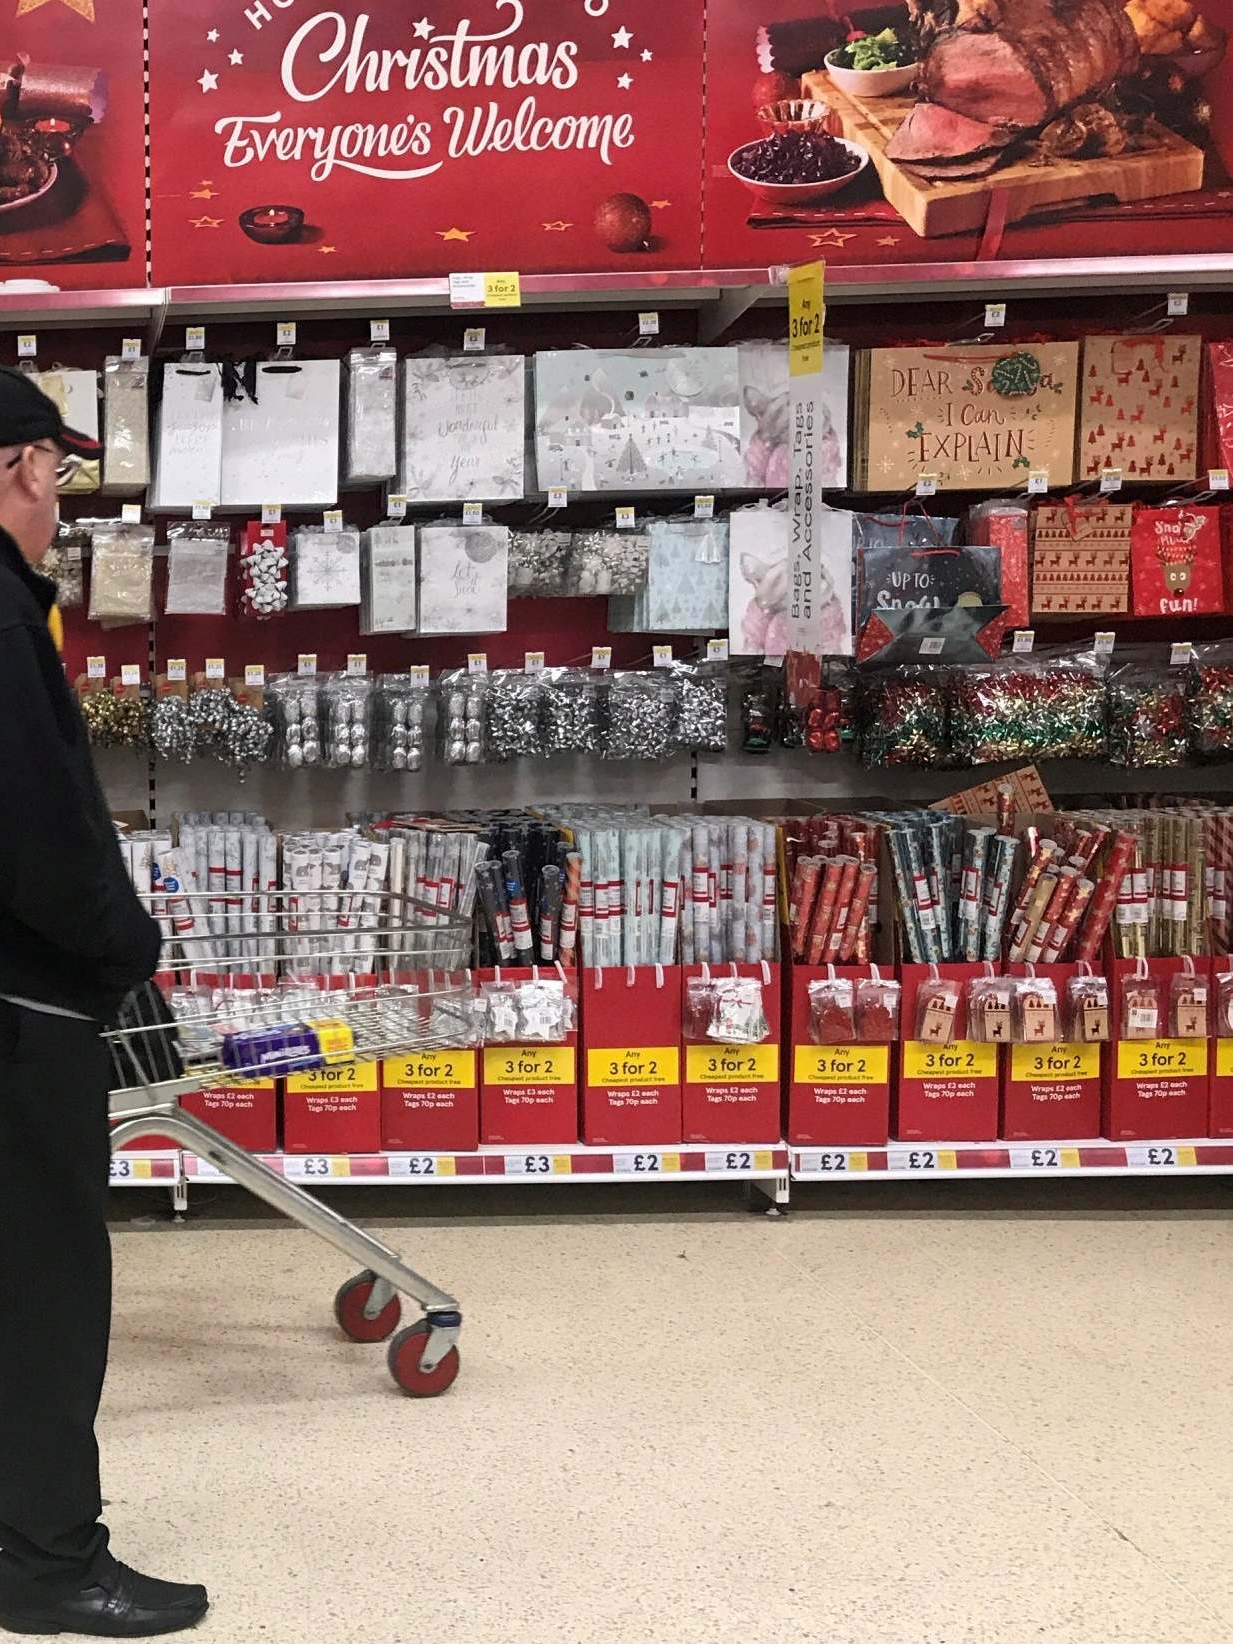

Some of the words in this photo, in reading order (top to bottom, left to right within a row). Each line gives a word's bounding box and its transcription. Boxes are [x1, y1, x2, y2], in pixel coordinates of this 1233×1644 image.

[281, 0, 578, 102] Christmas
[214, 111, 443, 181] Everyone's
[443, 96, 635, 166] Welcome
[792, 318, 797, 338] 3
[799, 316, 812, 336] for
[814, 313, 820, 333] 2
[892, 368, 953, 397] DEAR
[946, 402, 953, 426] I
[961, 404, 1004, 426] Can
[919, 429, 1024, 462] EXPLAIN
[802, 401, 814, 561] Accessories
[892, 571, 911, 590] UP
[913, 572, 930, 589] TO
[802, 571, 812, 619] and
[1159, 598, 1198, 614] fun!
[724, 1047, 740, 1056] Any
[1051, 1044, 1067, 1054] Any
[1155, 1041, 1171, 1050] Any
[421, 1052, 437, 1061] Any
[625, 1050, 641, 1059] Any
[925, 1054, 935, 1066] 3
[939, 1053, 961, 1067] for
[965, 1053, 975, 1066] 2
[1034, 1057, 1043, 1069] 3
[1046, 1056, 1070, 1069] for
[1072, 1056, 1081, 1069] 2
[1139, 1053, 1148, 1066] 3
[1151, 1052, 1175, 1066] for
[1177, 1052, 1186, 1065] 2
[405, 1064, 414, 1077] 3
[417, 1063, 441, 1077] for
[444, 1063, 453, 1077] 2
[505, 1060, 514, 1073] 3
[517, 1060, 541, 1073] for
[544, 1060, 553, 1072] 2
[609, 1062, 618, 1074] 3
[621, 1061, 644, 1074] for
[648, 1061, 657, 1074] 2
[708, 1058, 717, 1071] 3
[720, 1058, 744, 1071] for
[747, 1058, 756, 1071] 2
[817, 1059, 826, 1072] 3
[830, 1059, 853, 1072] for
[857, 1059, 866, 1072] 2
[402, 1092, 426, 1100] Wraps
[426, 1092, 437, 1100] £2
[438, 1092, 455, 1100] each
[705, 1087, 729, 1095] Wraps
[740, 1086, 758, 1094] each
[707, 1094, 723, 1103] Tags
[723, 1094, 738, 1103] 70p
[739, 1094, 757, 1102] each
[404, 1100, 420, 1108] Tags
[421, 1100, 435, 1108] 70p
[436, 1100, 454, 1108] each
[525, 1156, 550, 1173] £3
[634, 1154, 659, 1171] £2
[726, 1153, 751, 1169] £2
[821, 1154, 846, 1170] £2
[909, 1152, 934, 1169] £2
[1031, 1150, 1058, 1167] £2
[1148, 1149, 1174, 1165] £2
[304, 1159, 329, 1175] £3
[409, 1158, 434, 1174] £2
